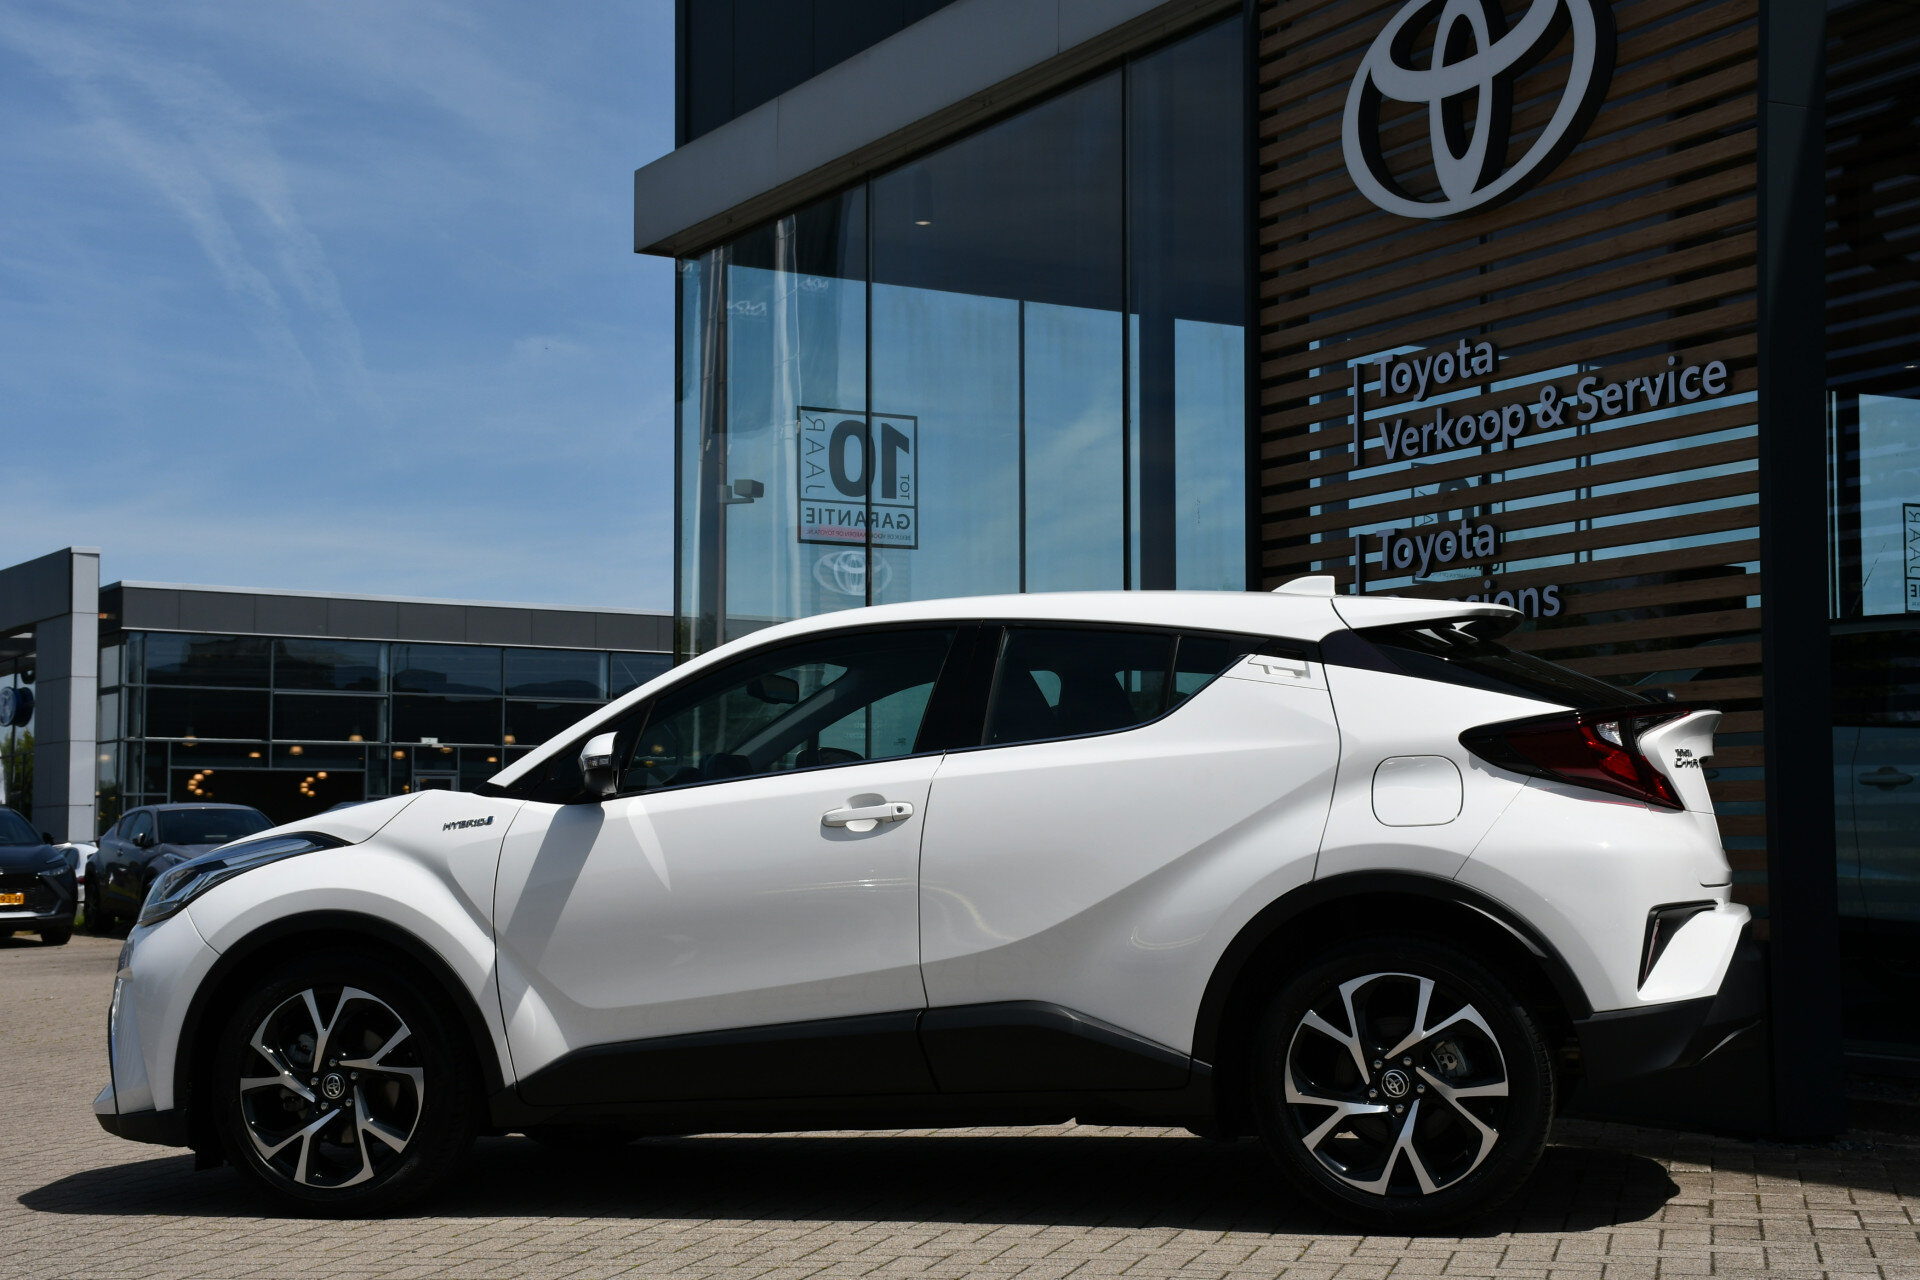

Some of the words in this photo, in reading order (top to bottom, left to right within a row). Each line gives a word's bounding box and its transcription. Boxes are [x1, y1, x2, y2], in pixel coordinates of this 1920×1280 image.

[1373, 338, 1494, 401] Toyota
[1379, 403, 1526, 460] Verkoop
[1536, 385, 1565, 429] &
[1577, 355, 1728, 421] Service
[1376, 518, 1496, 577] Toyota
